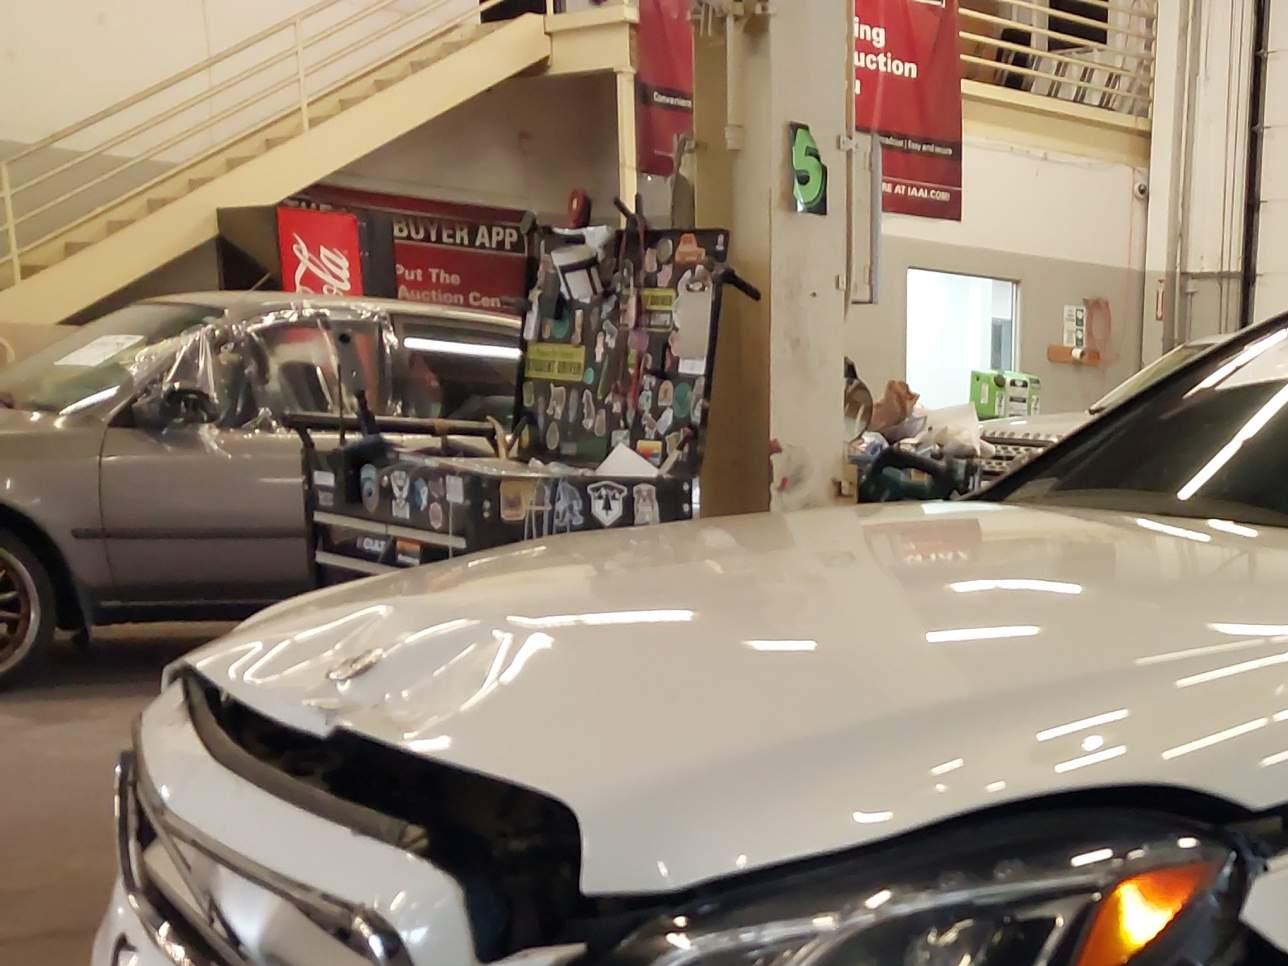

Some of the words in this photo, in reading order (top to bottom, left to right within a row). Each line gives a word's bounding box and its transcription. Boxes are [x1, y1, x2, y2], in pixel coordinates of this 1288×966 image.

[894, 184, 906, 195] AT
[393, 217, 469, 246] BUYER
[475, 224, 518, 250] APP
[395, 263, 423, 282] Put
[428, 267, 461, 286] The
[397, 284, 464, 305] Auction
